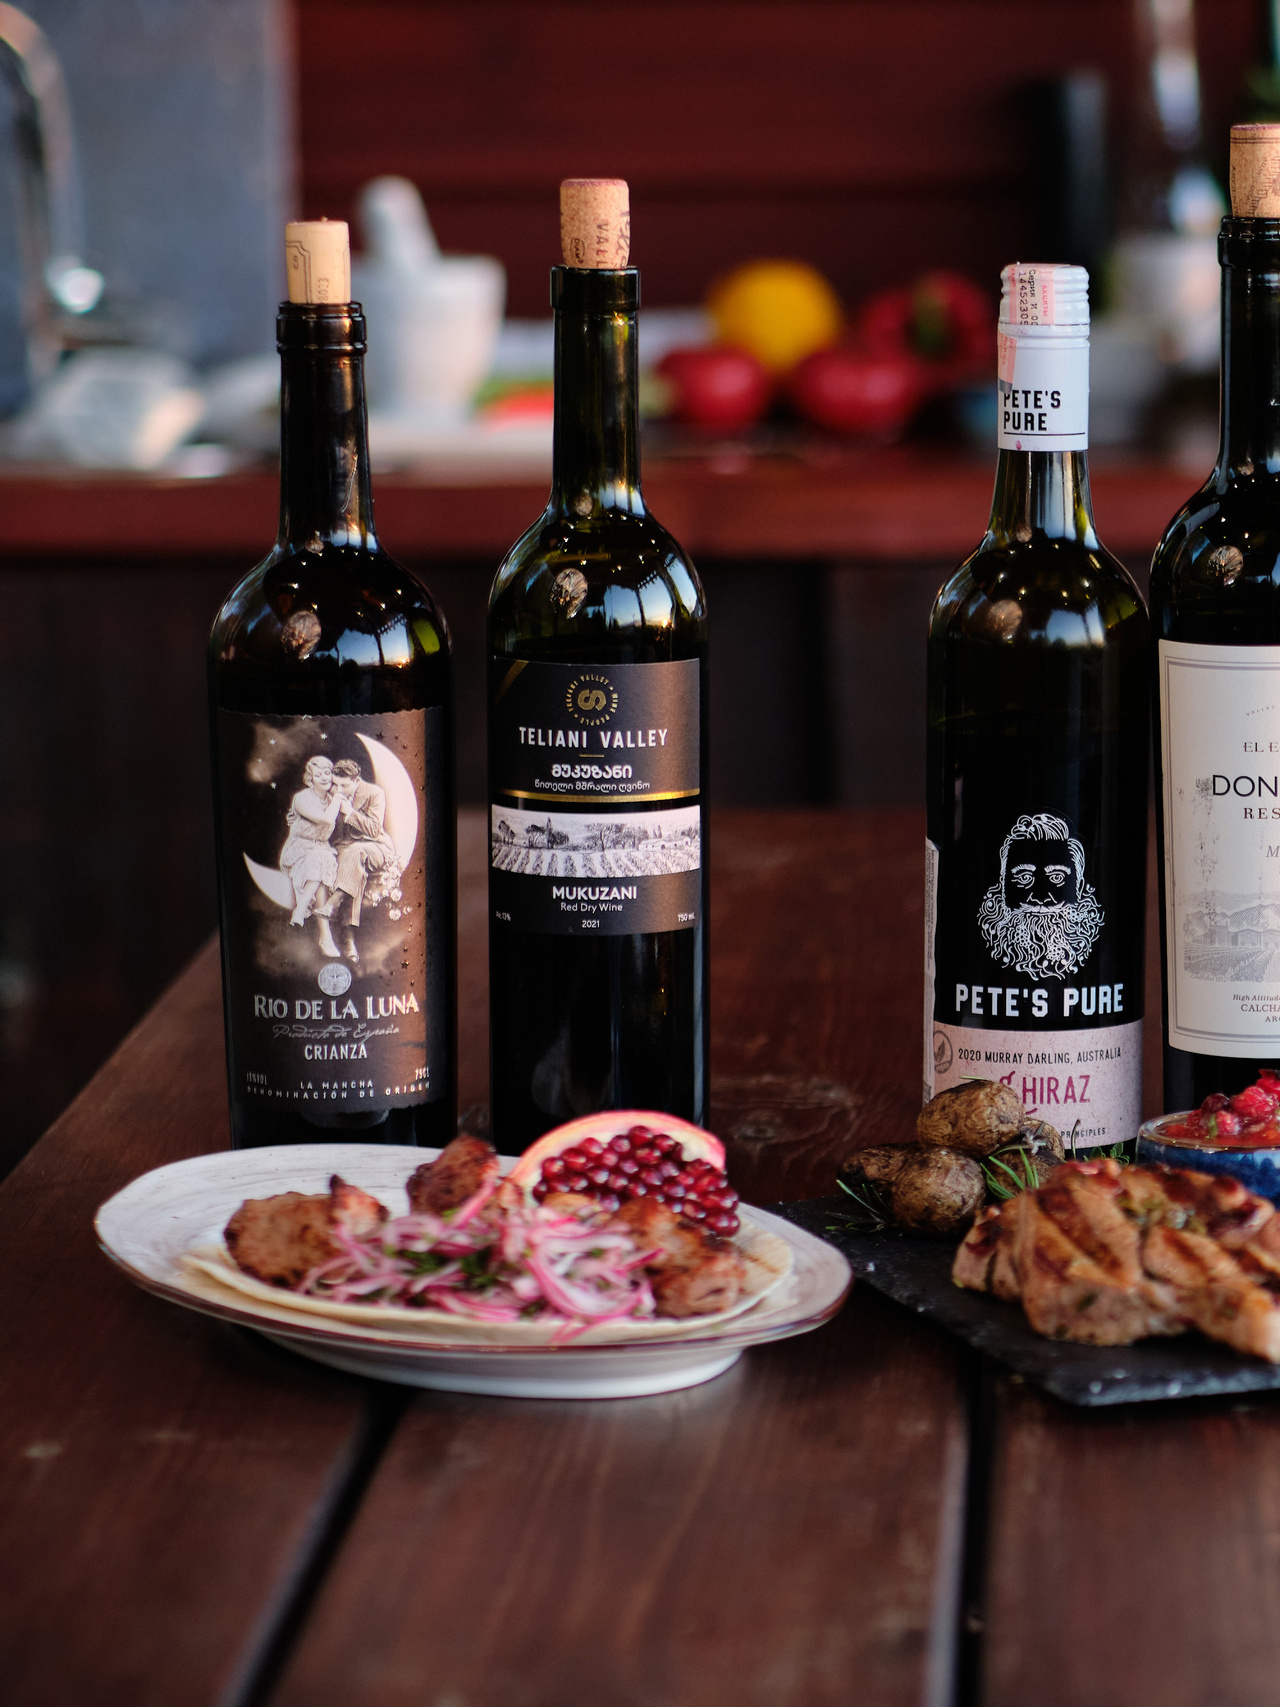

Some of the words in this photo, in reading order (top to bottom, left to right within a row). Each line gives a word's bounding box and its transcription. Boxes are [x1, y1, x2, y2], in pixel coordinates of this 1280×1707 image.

[1028, 269, 1036, 297] Серия
[1004, 390, 1061, 409] PETE'S
[1004, 411, 1047, 431] PURE
[519, 726, 587, 748] TELIANI
[600, 729, 668, 748] VALLEY
[1243, 742, 1264, 753] EL
[551, 764, 633, 779] მუკუზანი
[534, 779, 574, 793] წითელი
[575, 780, 617, 793] მშრალი
[619, 780, 650, 793] ღვინო
[1212, 775, 1278, 797] DON
[553, 885, 637, 900] MUKUZANI
[561, 903, 578, 912] Red
[580, 903, 597, 914] Dry
[599, 903, 623, 912] Wine
[582, 920, 600, 929] 2021
[956, 983, 1048, 1018] PETE'S
[1063, 983, 1123, 1017] PURE
[1233, 994, 1250, 1002] High
[254, 995, 288, 1019] RIO
[296, 999, 323, 1020] DE
[331, 1000, 359, 1020] LA
[366, 993, 420, 1020] LUNA
[273, 1024, 329, 1039] Producto
[305, 1043, 368, 1061] CRIANZA
[958, 1048, 981, 1061] 2020
[985, 1051, 1023, 1064] MURRAY
[1028, 1052, 1073, 1065] DARLING,
[1077, 1047, 1121, 1063] AUSTRALIA
[301, 1081, 313, 1090] LA
[322, 1079, 373, 1090] MANCHA
[360, 1088, 375, 1098] DE
[385, 1082, 430, 1096] ORIGEN
